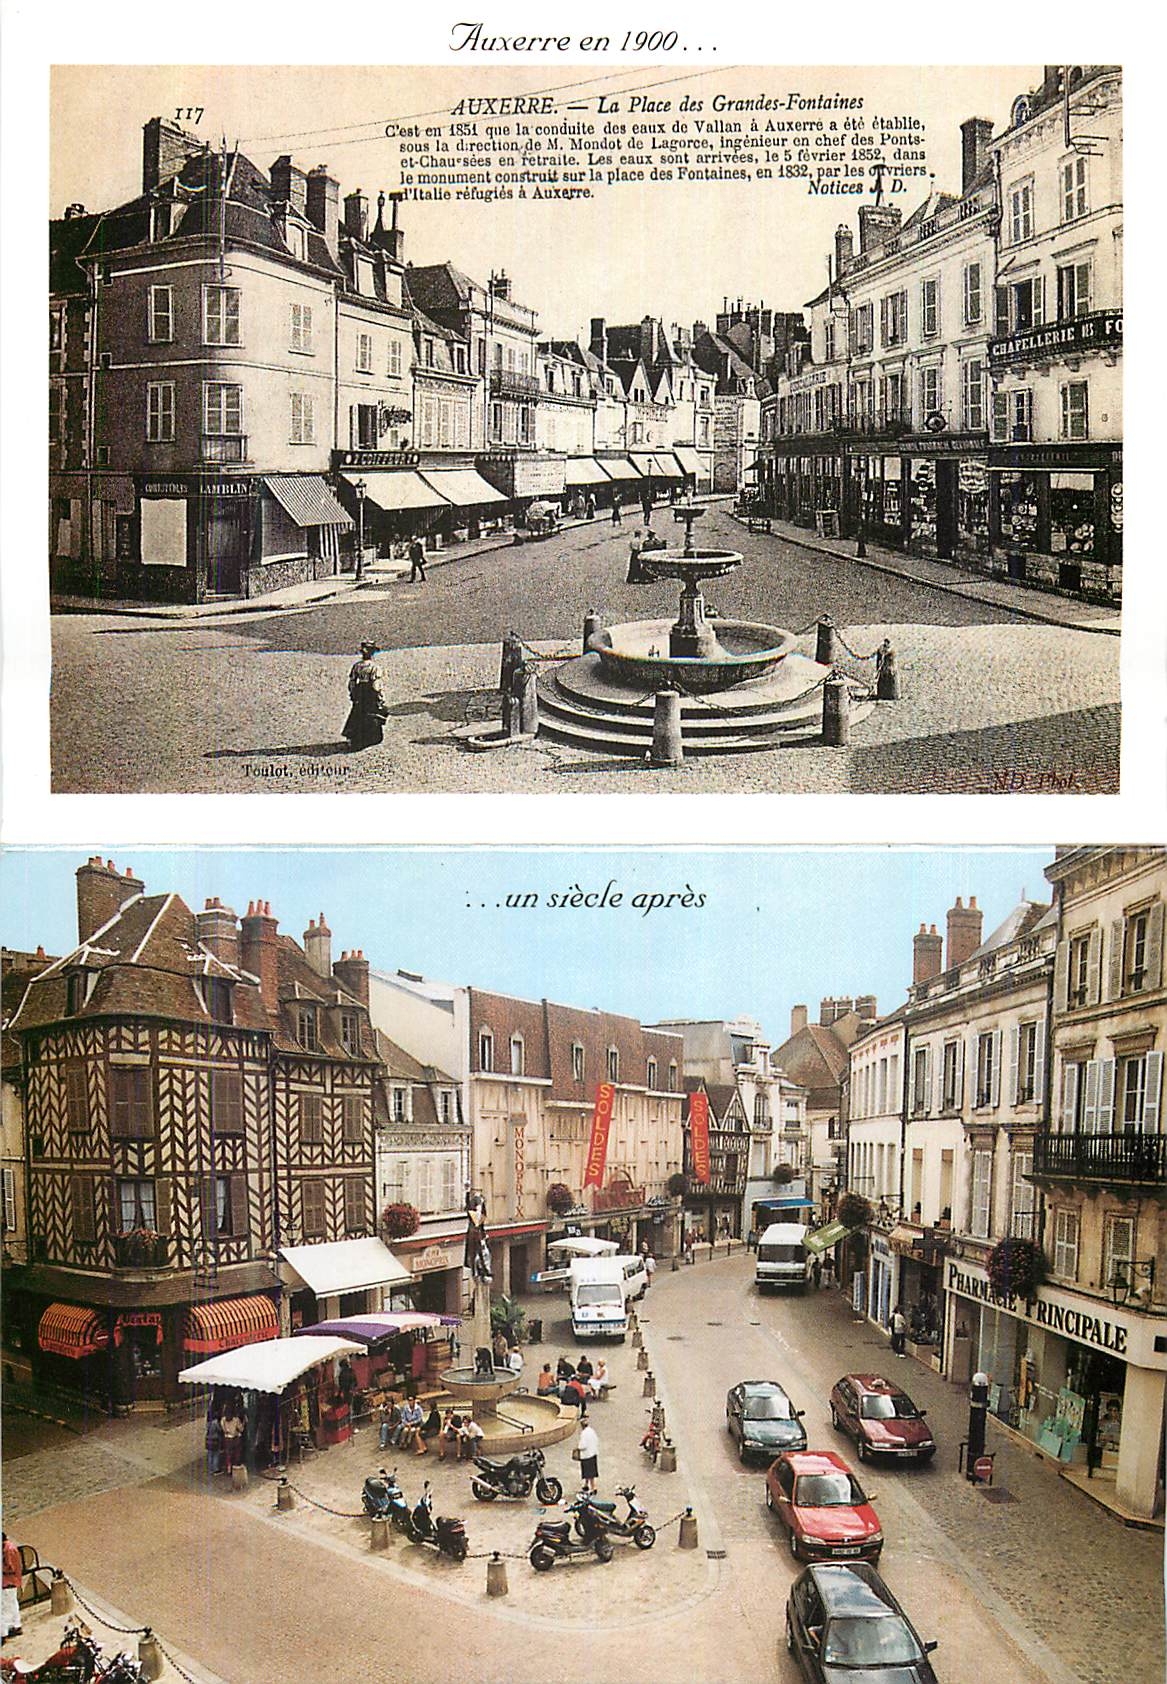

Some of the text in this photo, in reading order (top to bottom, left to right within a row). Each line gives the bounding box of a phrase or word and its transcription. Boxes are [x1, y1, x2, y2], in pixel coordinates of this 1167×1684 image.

[992, 327, 1075, 356] CHAPELLERIE
[200, 483, 248, 495] LAMBLIN
[588, 1084, 612, 1176] SOLDES
[693, 1101, 706, 1177] SOLDES
[514, 1128, 525, 1218] MONOPRIX
